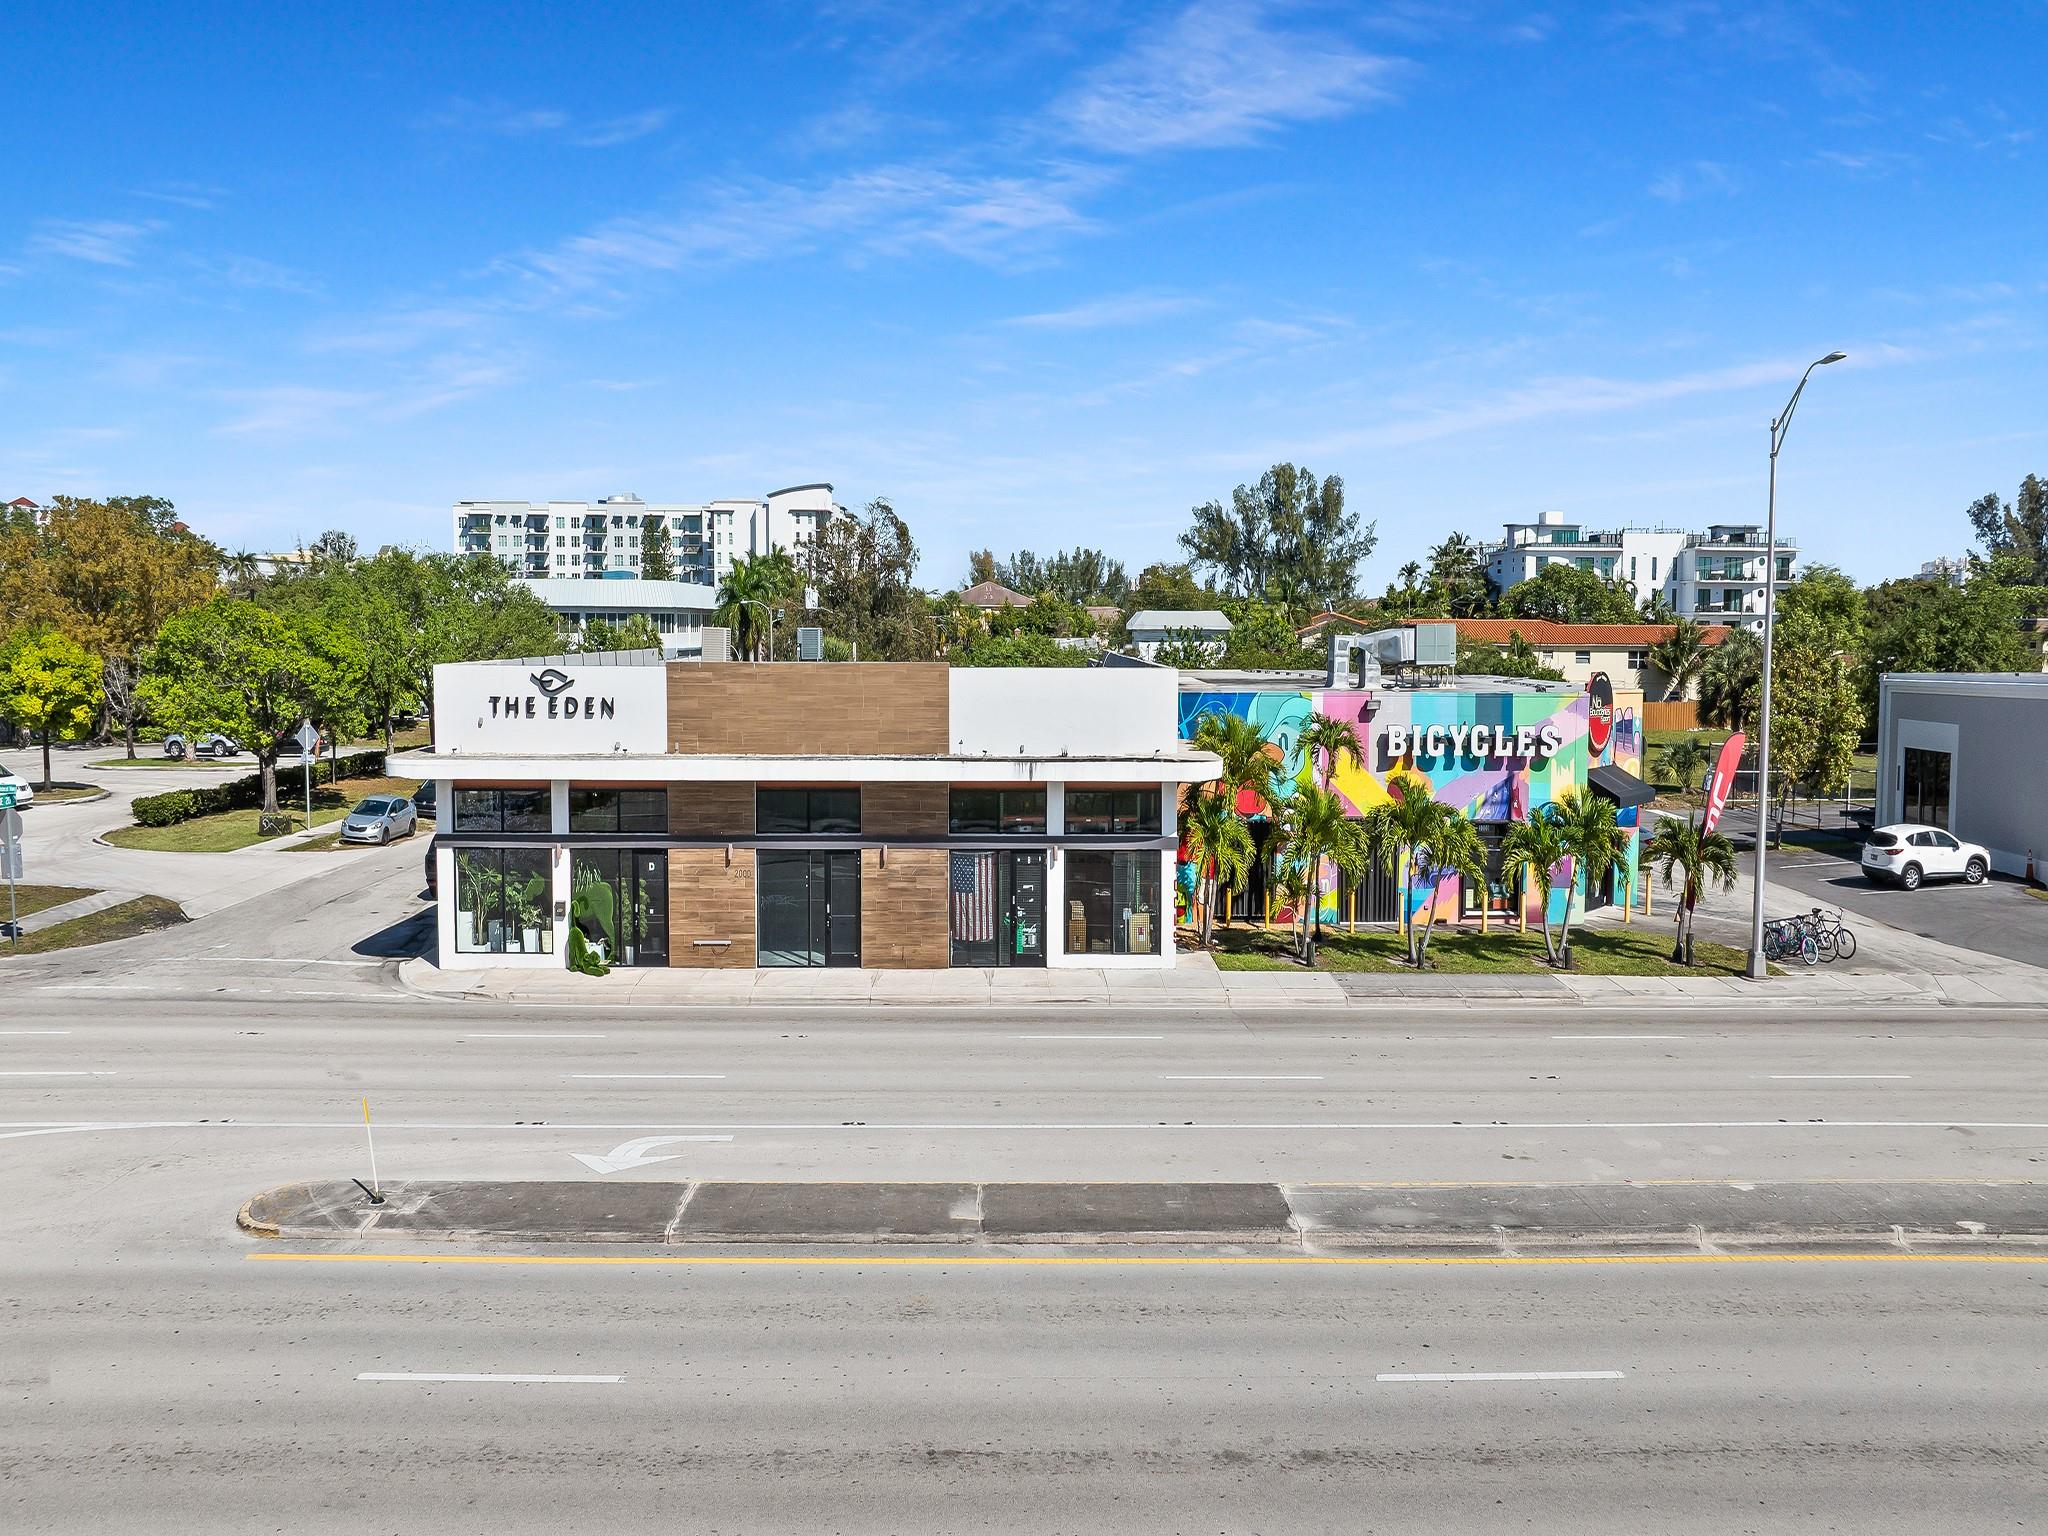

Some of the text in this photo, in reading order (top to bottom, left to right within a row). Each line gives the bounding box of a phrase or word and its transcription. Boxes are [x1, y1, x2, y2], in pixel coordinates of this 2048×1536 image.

[489, 696, 615, 720] THE EDEN
[1387, 724, 1560, 757] BICYCLES
[648, 862, 656, 871] D
